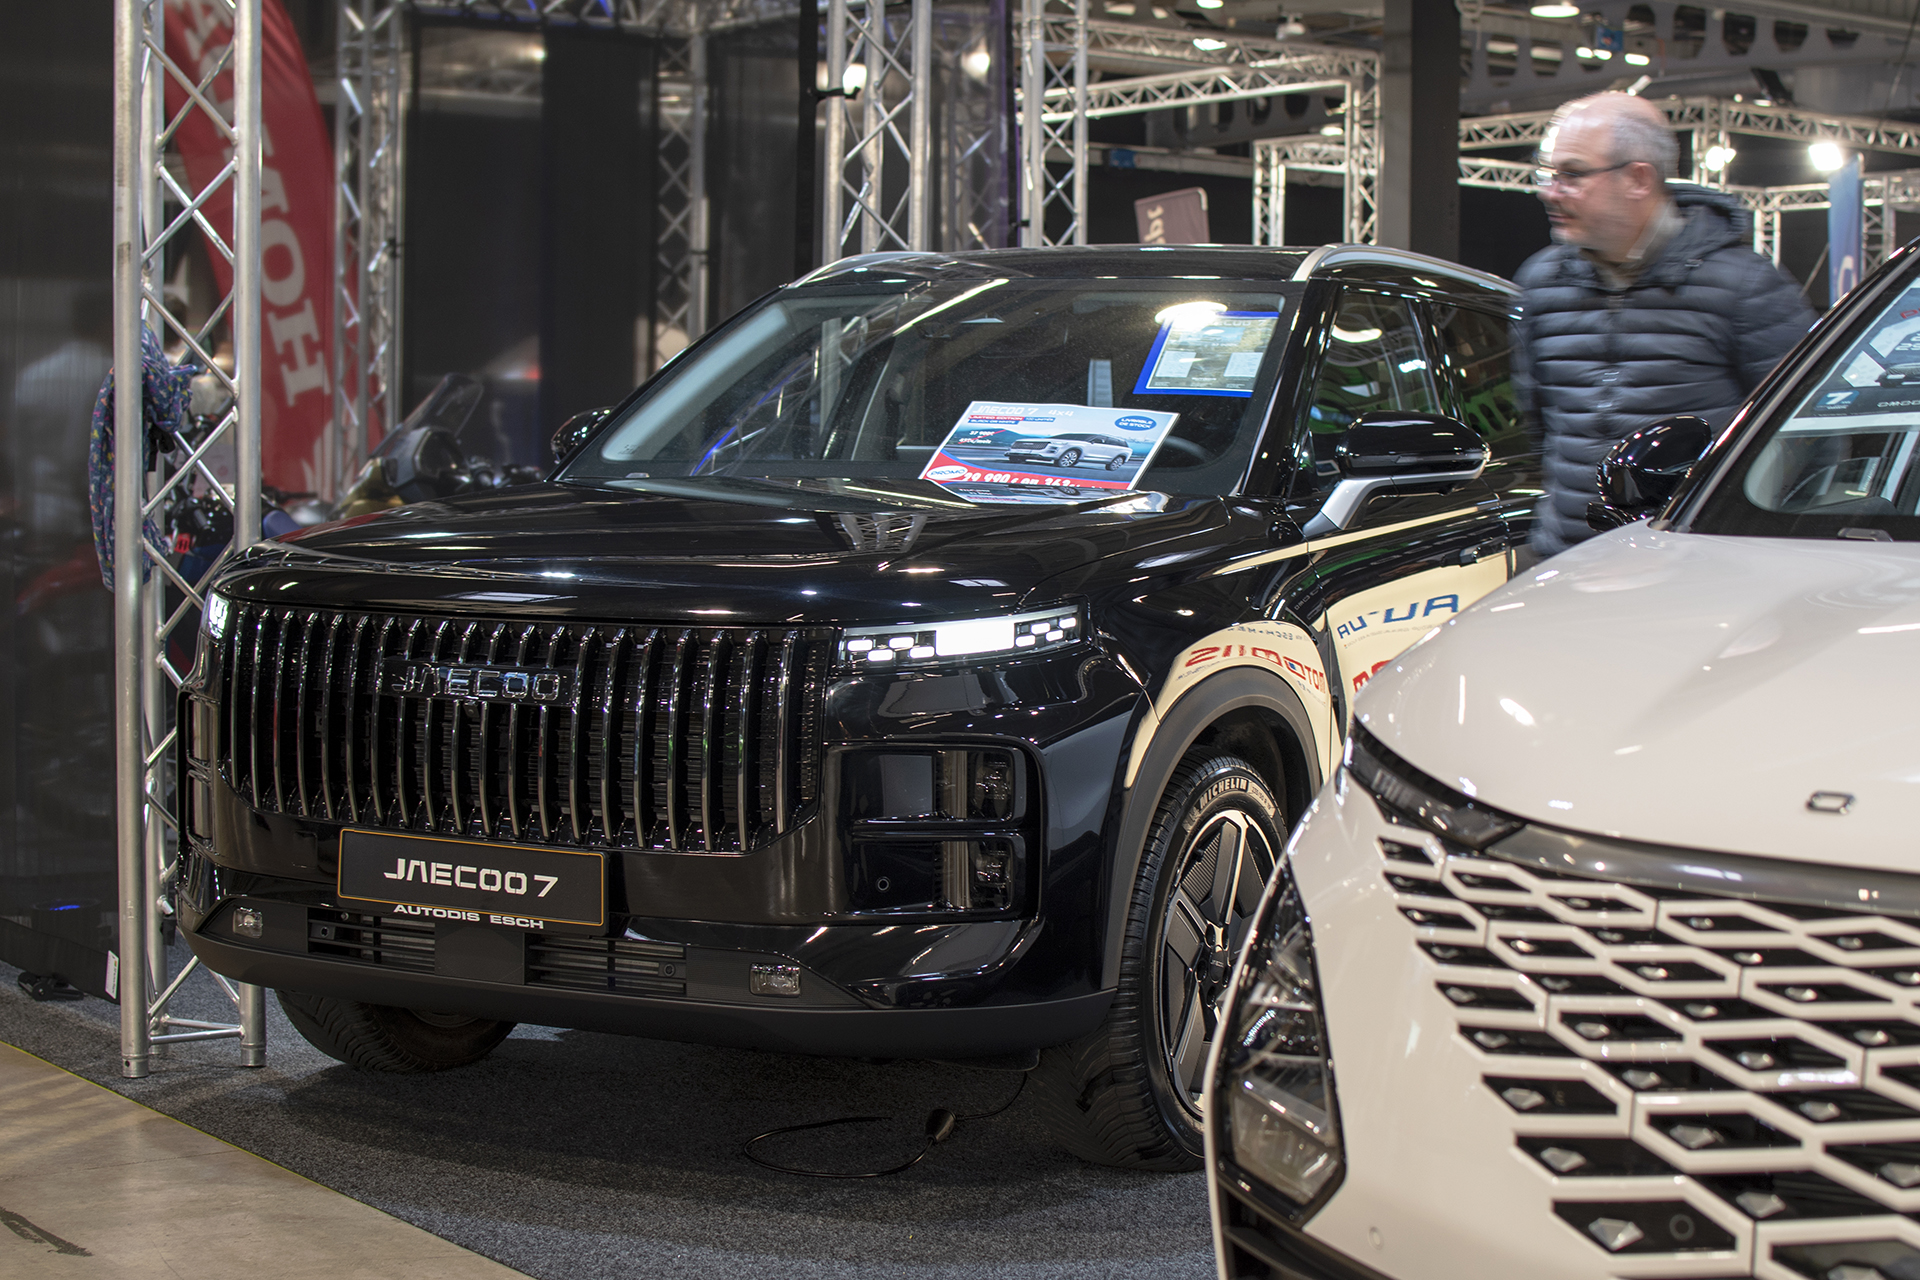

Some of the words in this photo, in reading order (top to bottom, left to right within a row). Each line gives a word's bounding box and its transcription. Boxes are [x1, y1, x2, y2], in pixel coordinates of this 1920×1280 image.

[972, 405, 1025, 415] JAECOO
[1027, 407, 1039, 415] 7
[930, 468, 966, 476] PROMO
[391, 665, 561, 701] JAECOO
[1199, 777, 1249, 810] MICHELIN
[383, 857, 528, 896] JAECOO
[533, 874, 559, 898] 7
[393, 904, 481, 923] AUTODIS
[489, 914, 544, 930] ESCH
